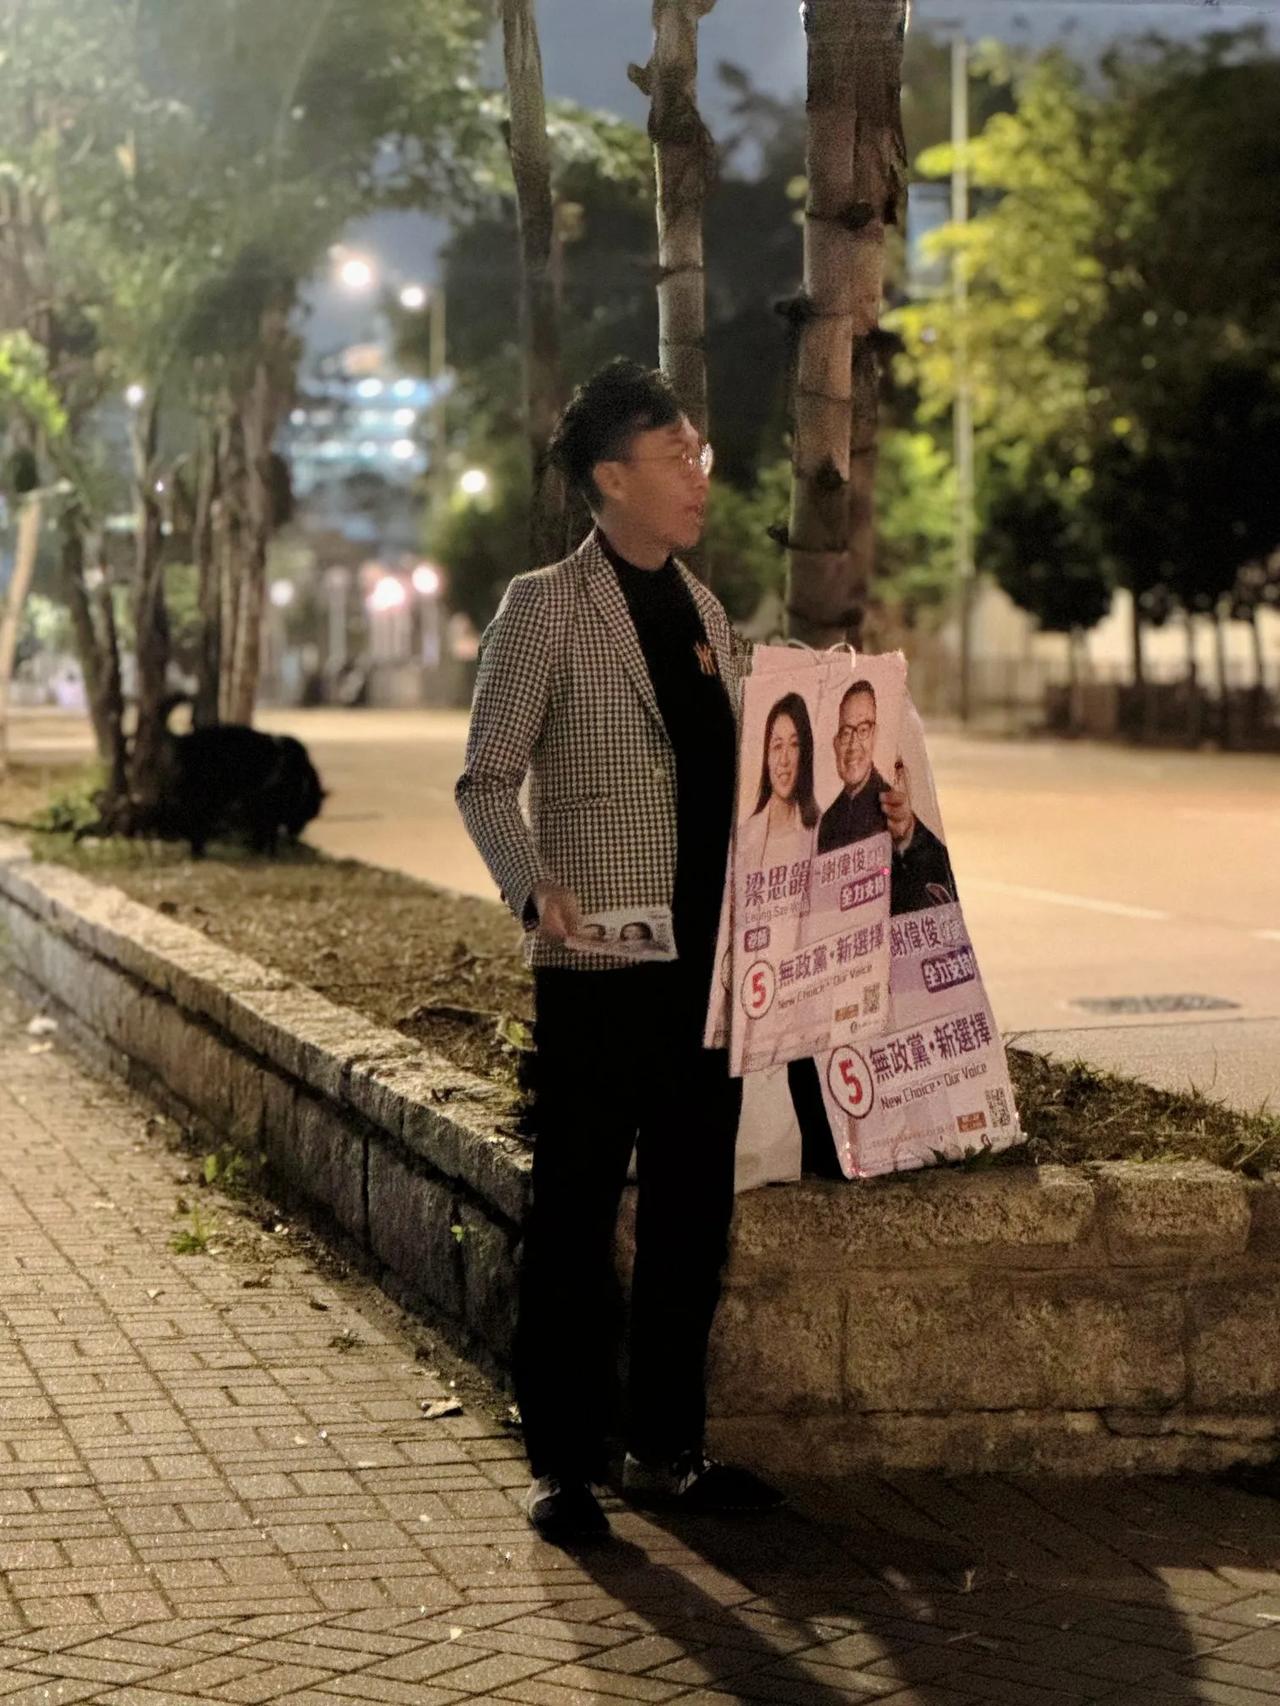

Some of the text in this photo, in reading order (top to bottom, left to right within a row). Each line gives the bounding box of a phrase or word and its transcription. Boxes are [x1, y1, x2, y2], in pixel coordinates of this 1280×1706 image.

[841, 873, 885, 908] 全力支持
[923, 951, 974, 987] 全力支持
[839, 1058, 864, 1105] 5
[880, 1062, 988, 1111] New Choice Our Voice
